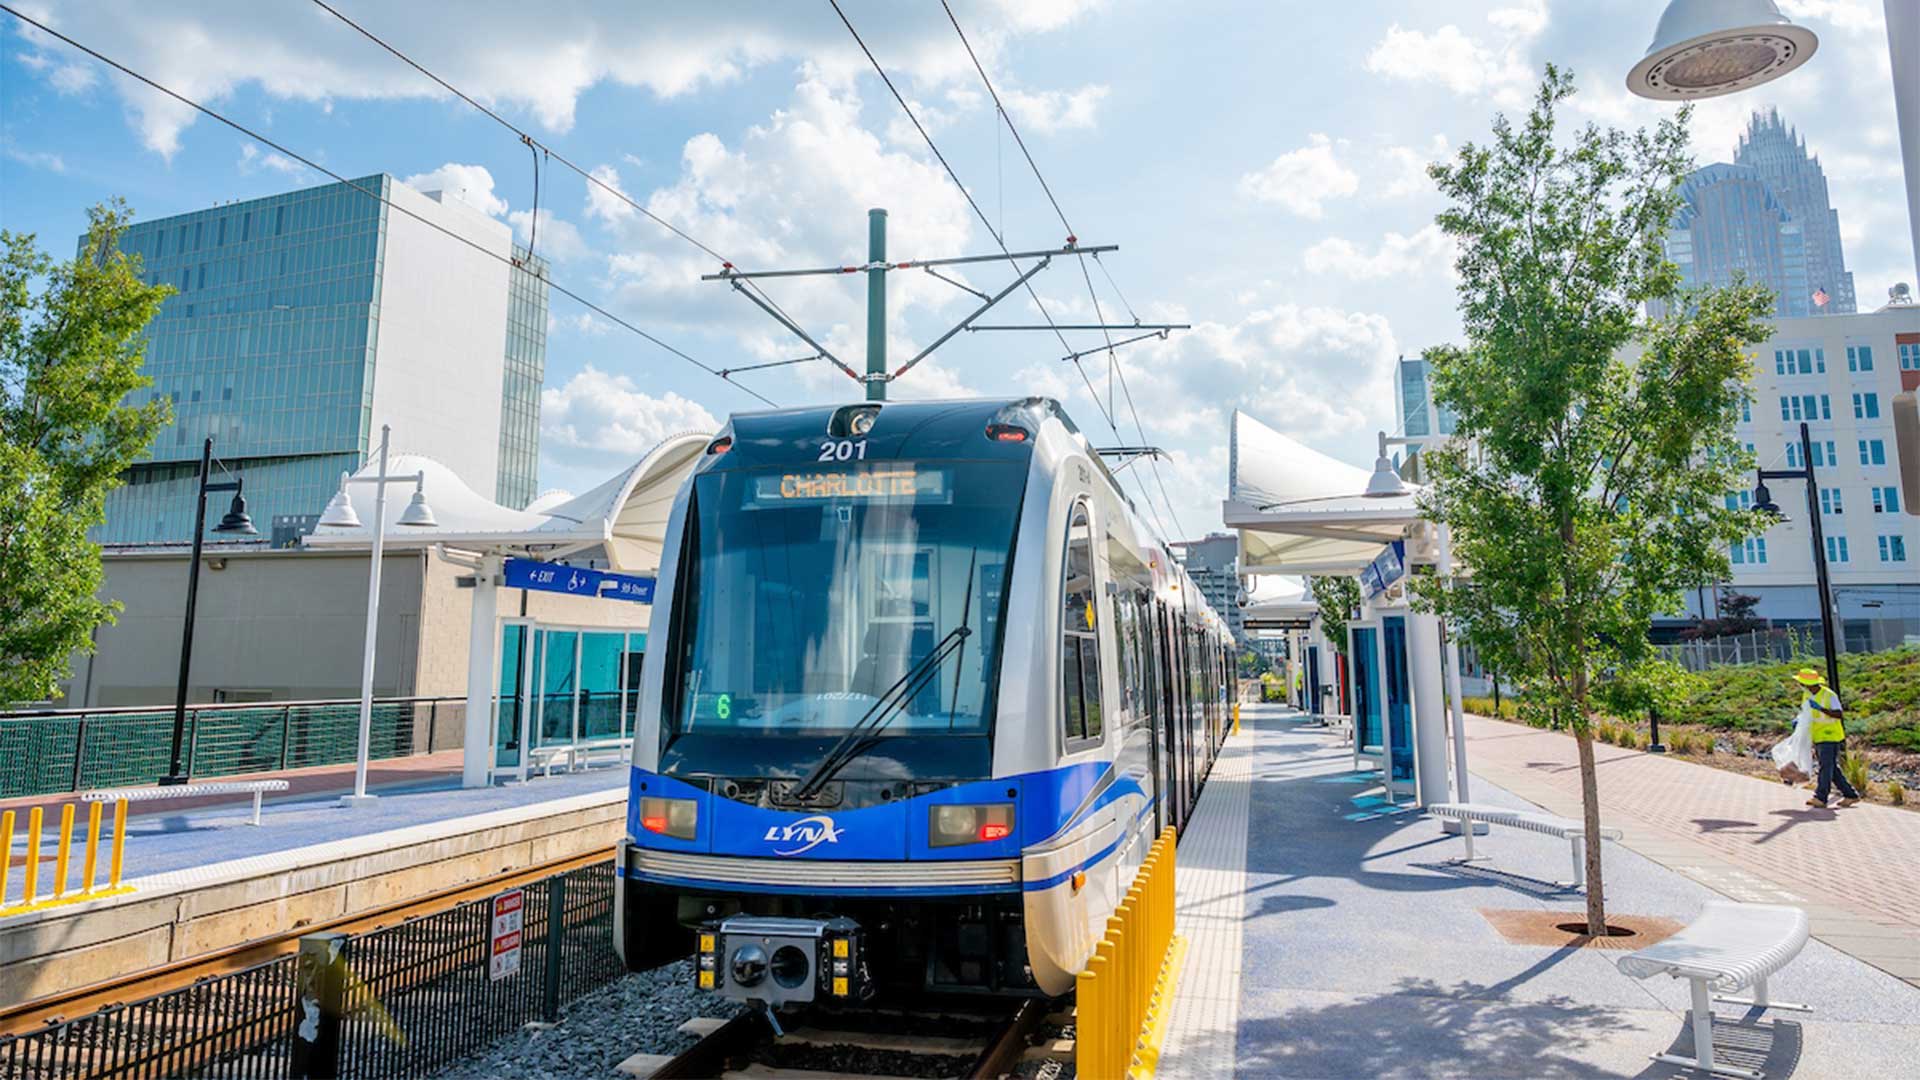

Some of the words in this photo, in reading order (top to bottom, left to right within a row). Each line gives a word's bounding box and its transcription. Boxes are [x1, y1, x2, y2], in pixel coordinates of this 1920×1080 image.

[818, 440, 867, 462] 201
[780, 470, 917, 498] CHARLOTTE
[538, 570, 555, 583] EXIT
[717, 693, 730, 719] 6
[764, 816, 845, 843] LYNX
